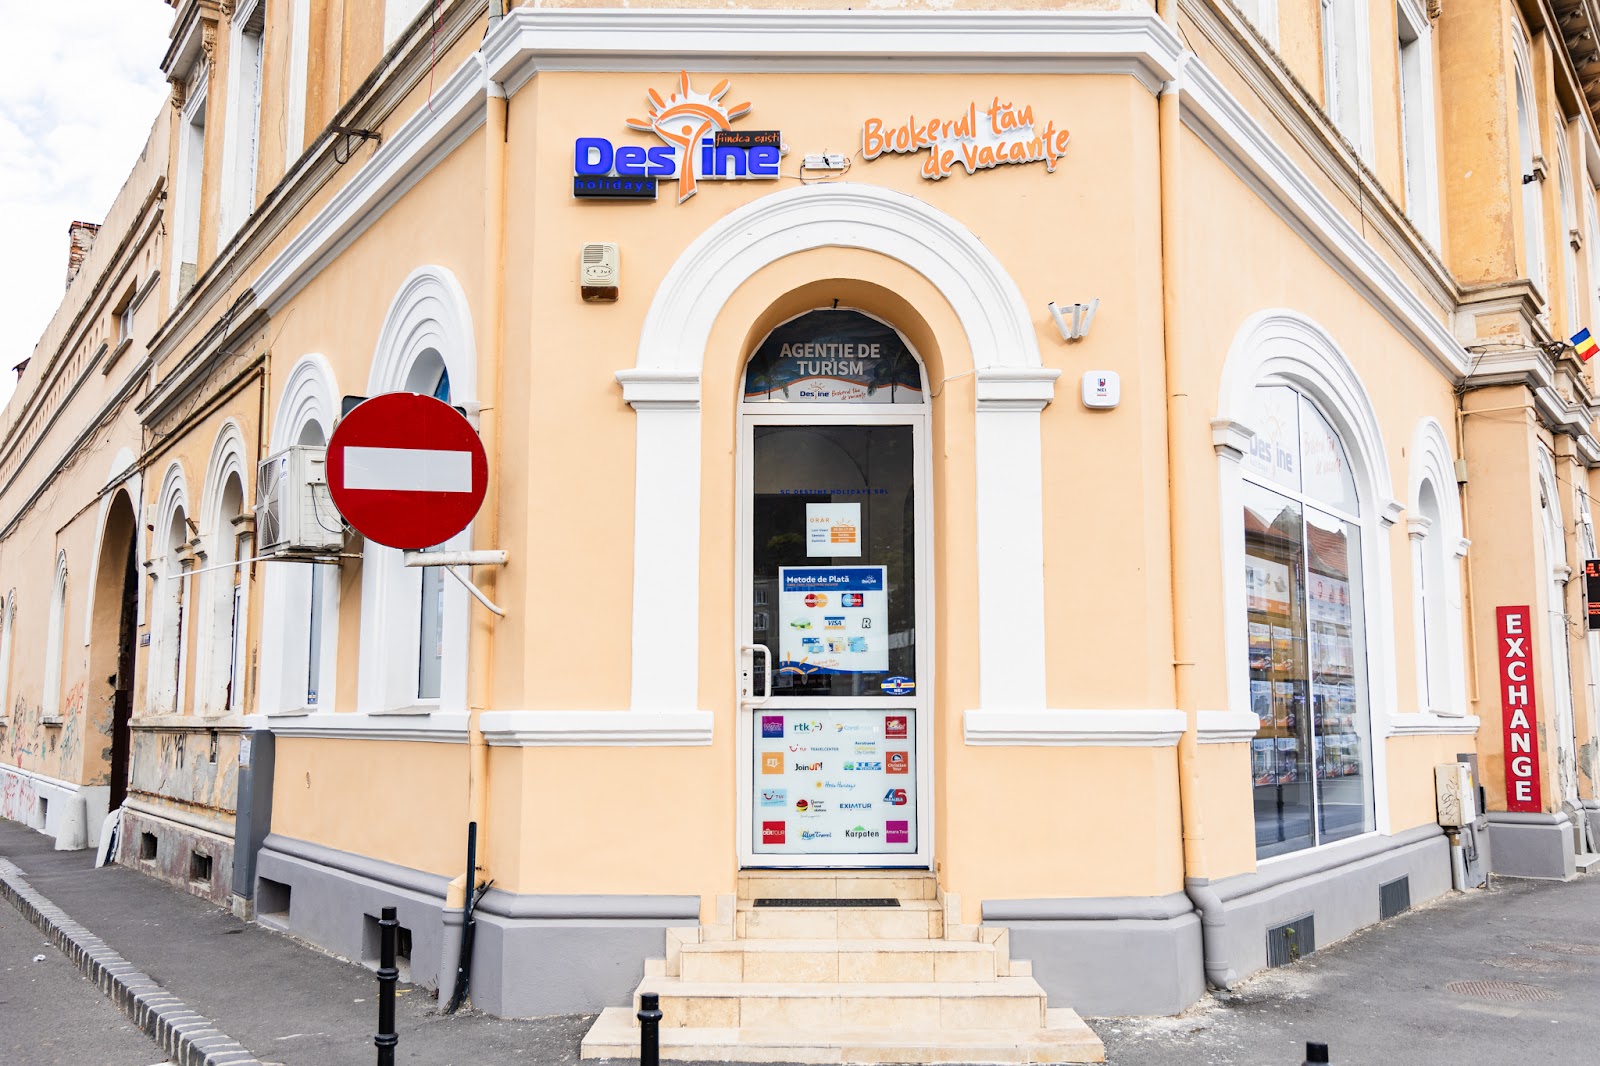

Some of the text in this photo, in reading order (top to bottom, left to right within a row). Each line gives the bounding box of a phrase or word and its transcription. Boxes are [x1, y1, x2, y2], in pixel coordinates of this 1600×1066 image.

[863, 96, 1035, 157] Brokerul tău
[923, 144, 955, 177] de
[575, 178, 655, 193] holidays
[858, 343, 880, 358] DE
[797, 360, 864, 376] TURISM
[786, 576, 816, 584] Metode
[828, 575, 850, 583] Plată
[1505, 614, 1532, 802] EXCHANGE
[794, 722, 810, 731] rtk
[845, 829, 880, 839] Karpaten
